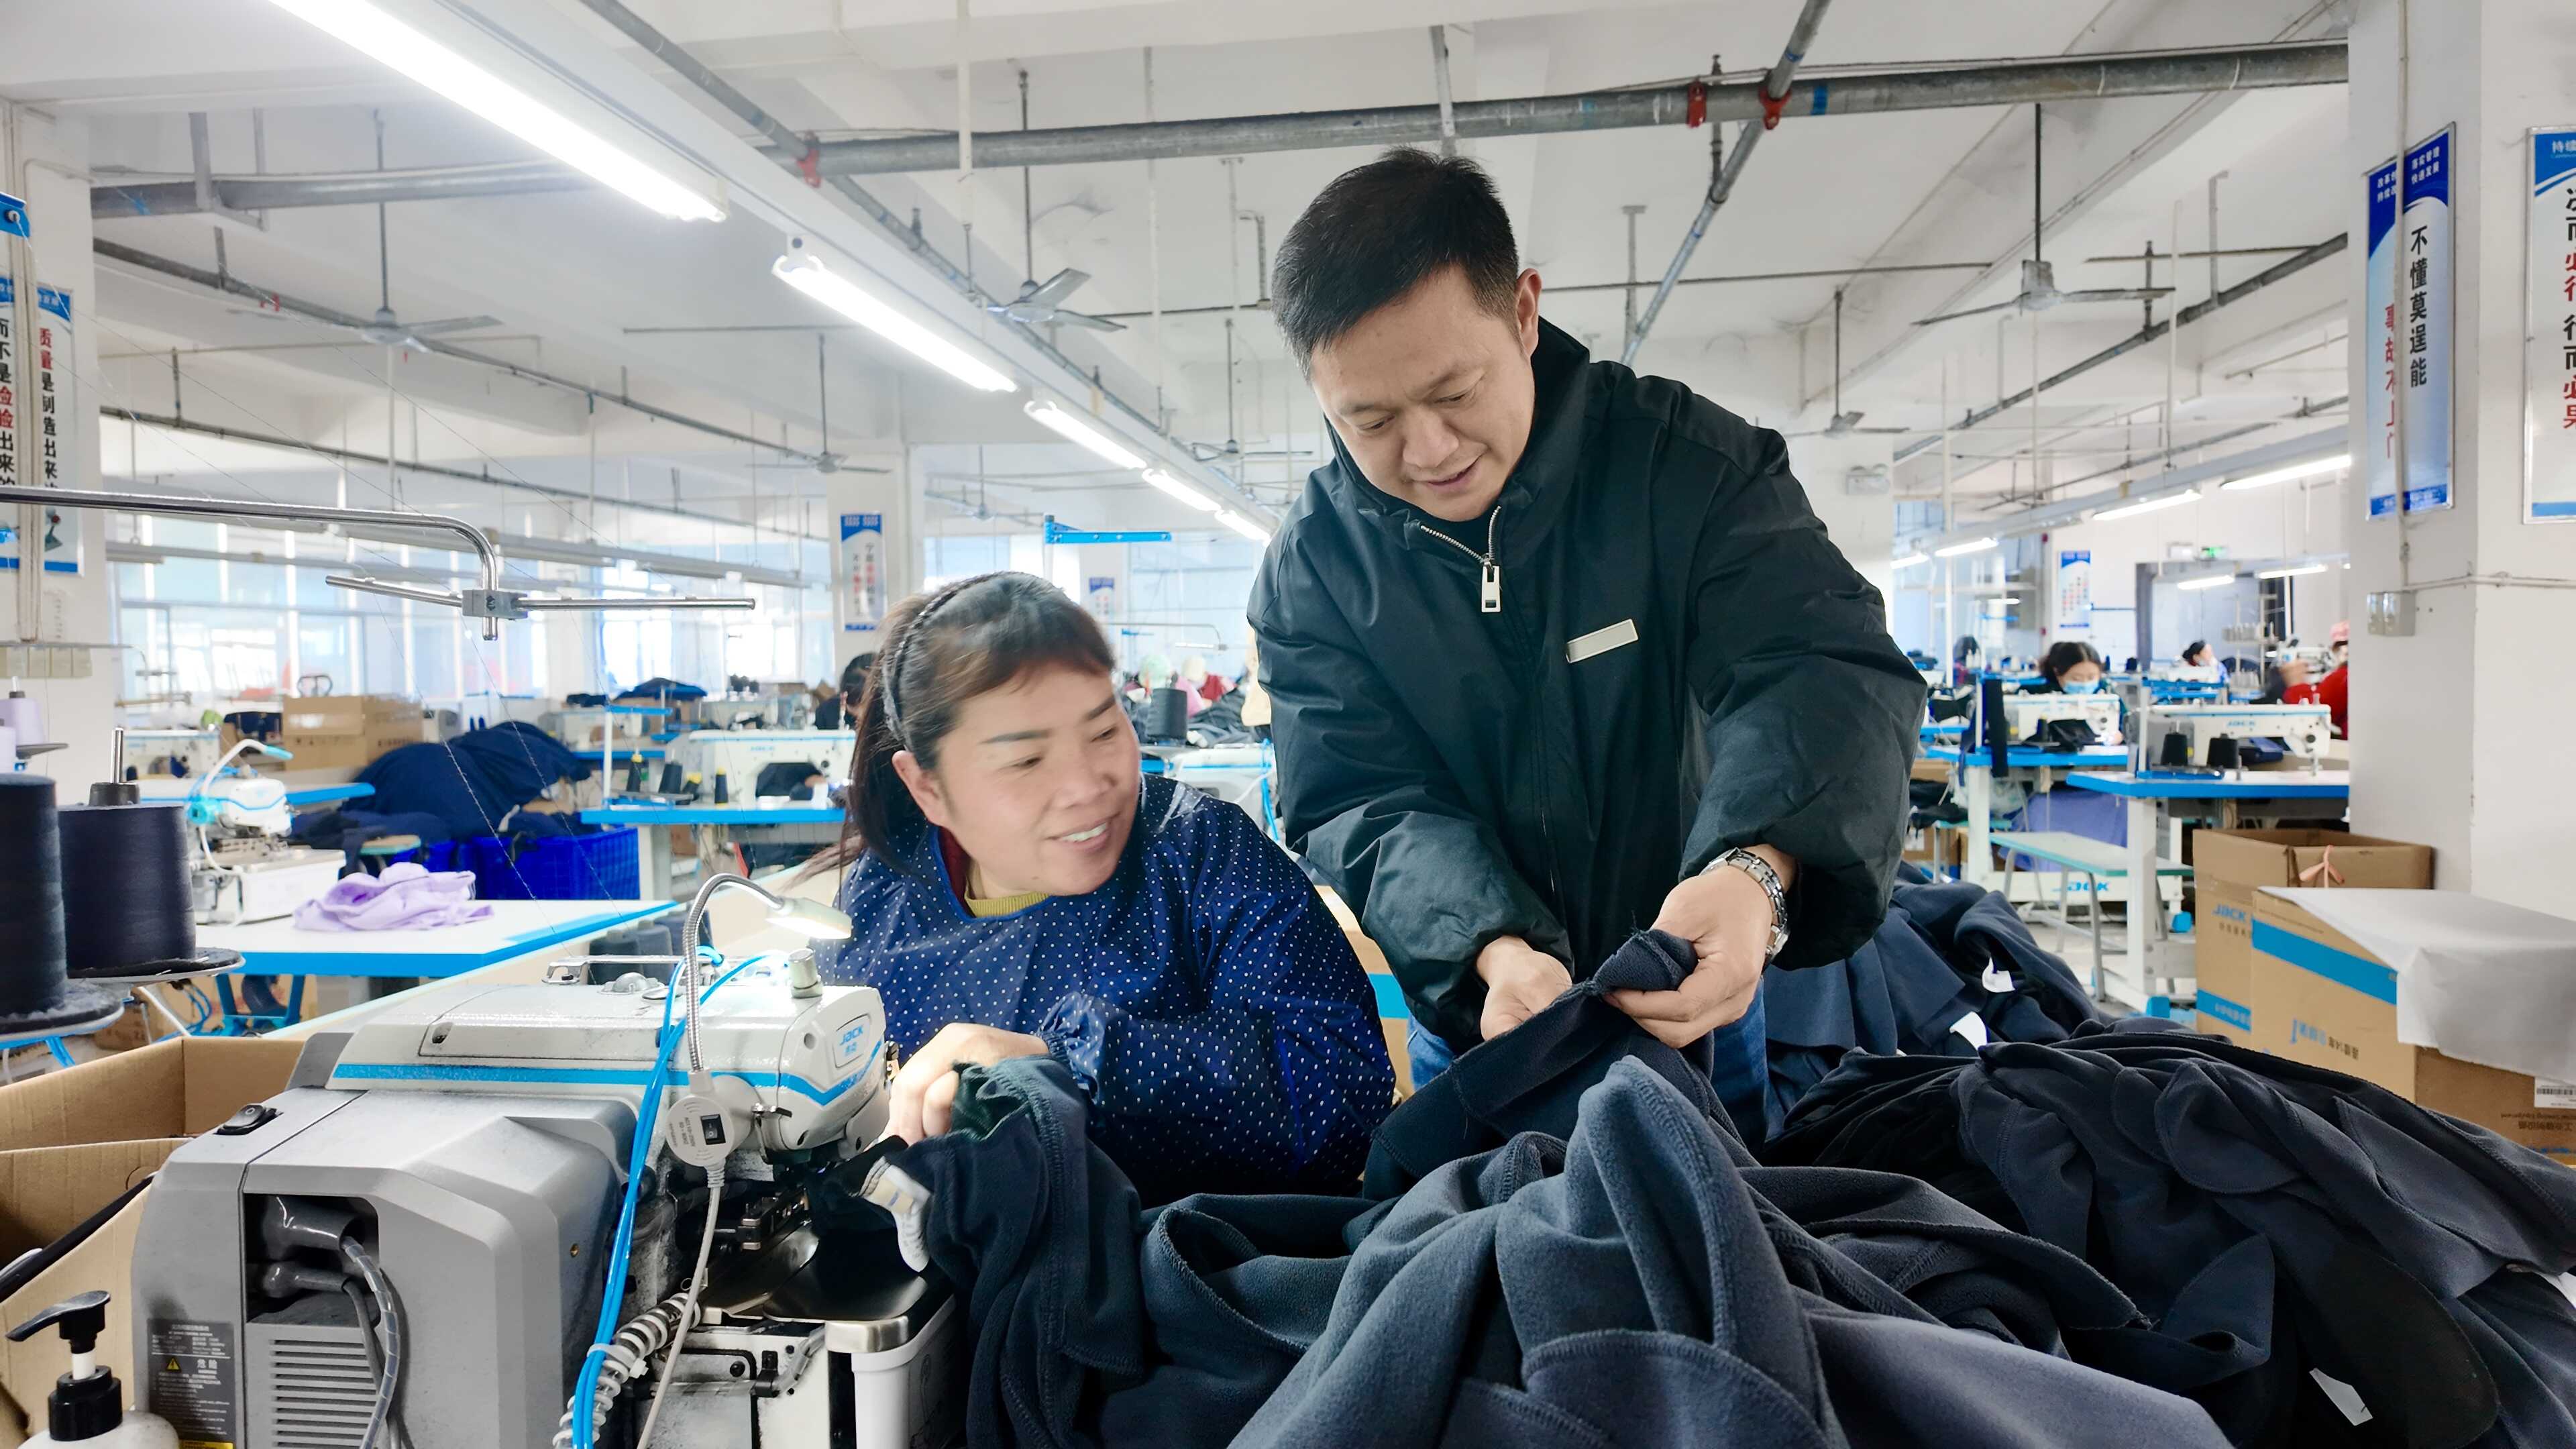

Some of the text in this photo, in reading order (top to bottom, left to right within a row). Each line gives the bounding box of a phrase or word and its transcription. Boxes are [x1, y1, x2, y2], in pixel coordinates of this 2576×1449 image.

[2410, 225, 2428, 388] 不懂莫逞能
[40, 327, 58, 488] 质量是制造出来
